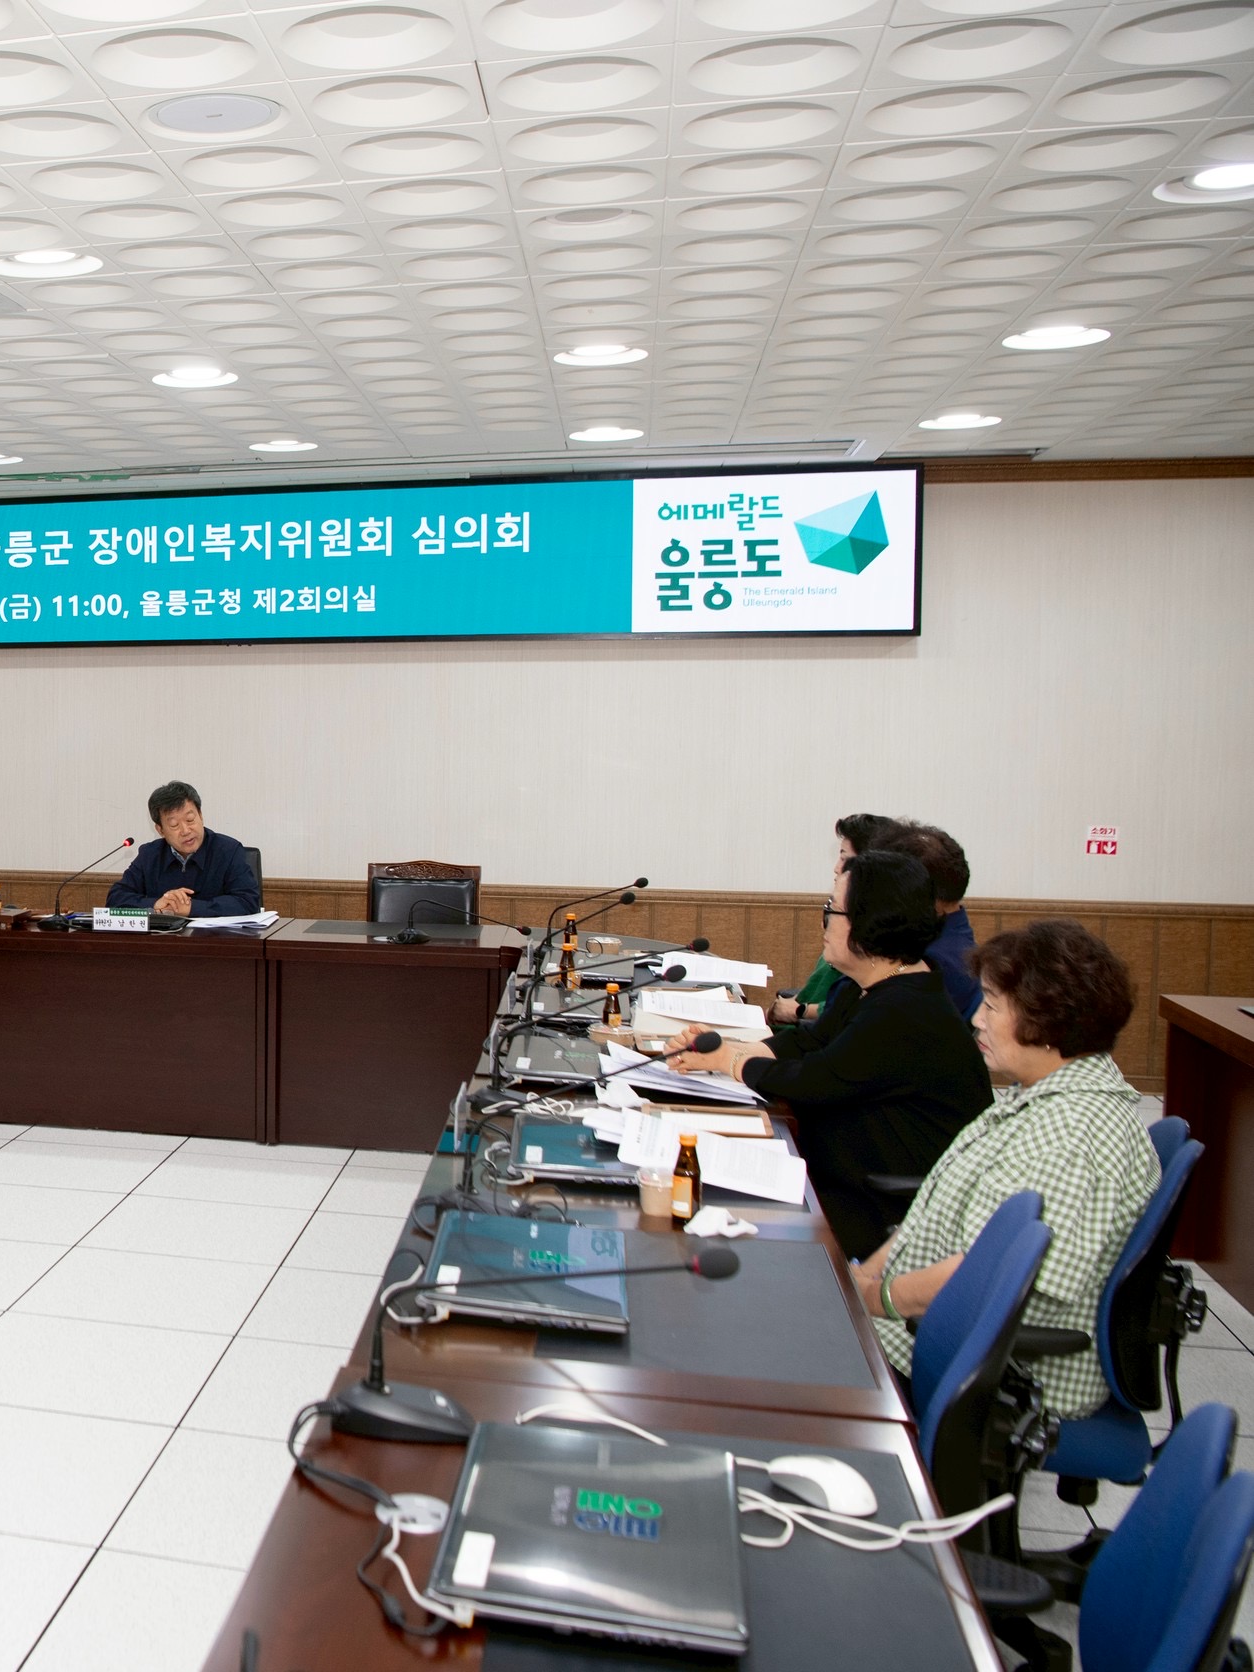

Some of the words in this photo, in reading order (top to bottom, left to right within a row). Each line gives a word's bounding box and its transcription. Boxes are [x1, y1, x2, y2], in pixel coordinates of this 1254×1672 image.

[657, 493, 783, 531] 에메랄드
[88, 516, 393, 565] 장애인복지위원회
[411, 511, 530, 555] 심의회
[654, 538, 782, 611] 울릉도
[743, 587, 761, 596] The
[764, 586, 805, 596] Emerald
[807, 586, 838, 595] Island
[52, 594, 129, 620] 11:00,
[139, 588, 241, 617] 울릉군청
[252, 585, 376, 614] 제2회의실
[742, 598, 793, 608] Ulleungdo
[1091, 827, 1116, 835] 소화기
